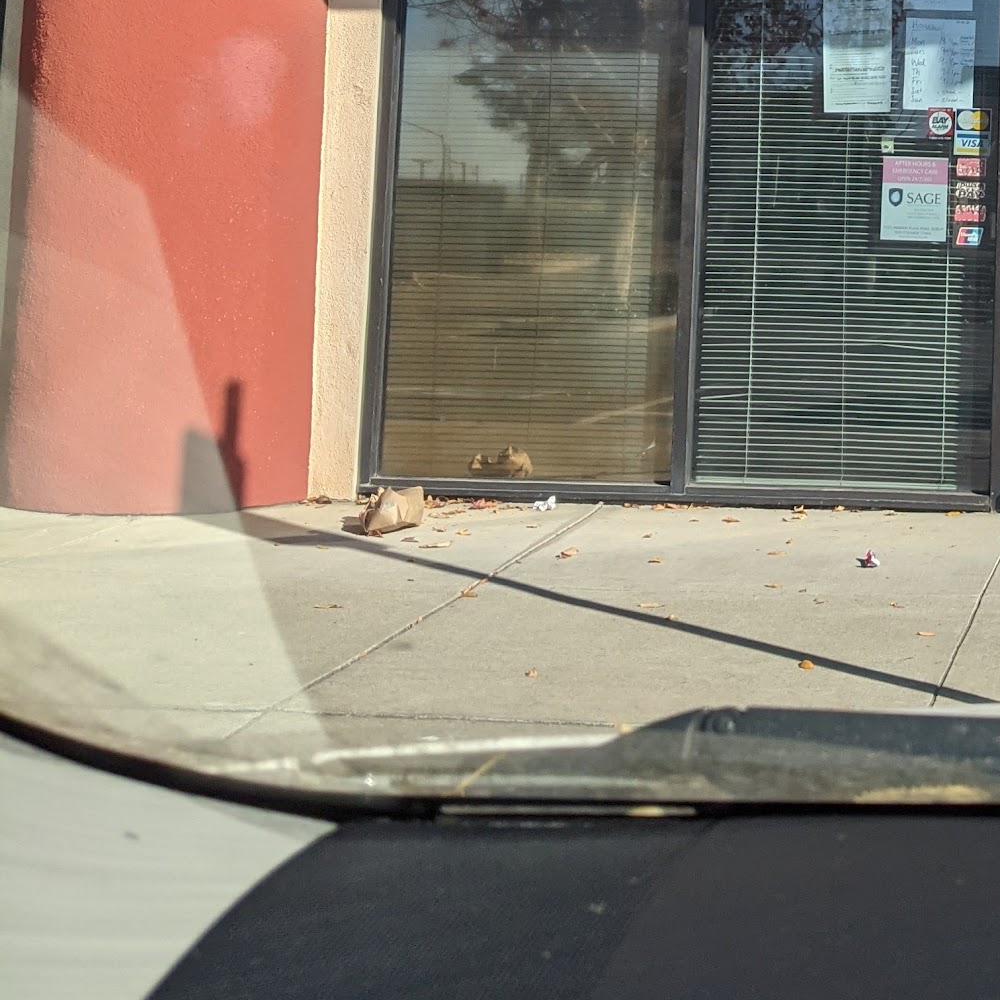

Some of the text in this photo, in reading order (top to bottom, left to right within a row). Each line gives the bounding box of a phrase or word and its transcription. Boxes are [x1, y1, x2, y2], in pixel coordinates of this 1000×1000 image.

[931, 116, 950, 124] BAY
[961, 139, 984, 148] VISA
[906, 192, 942, 205] SAGE
